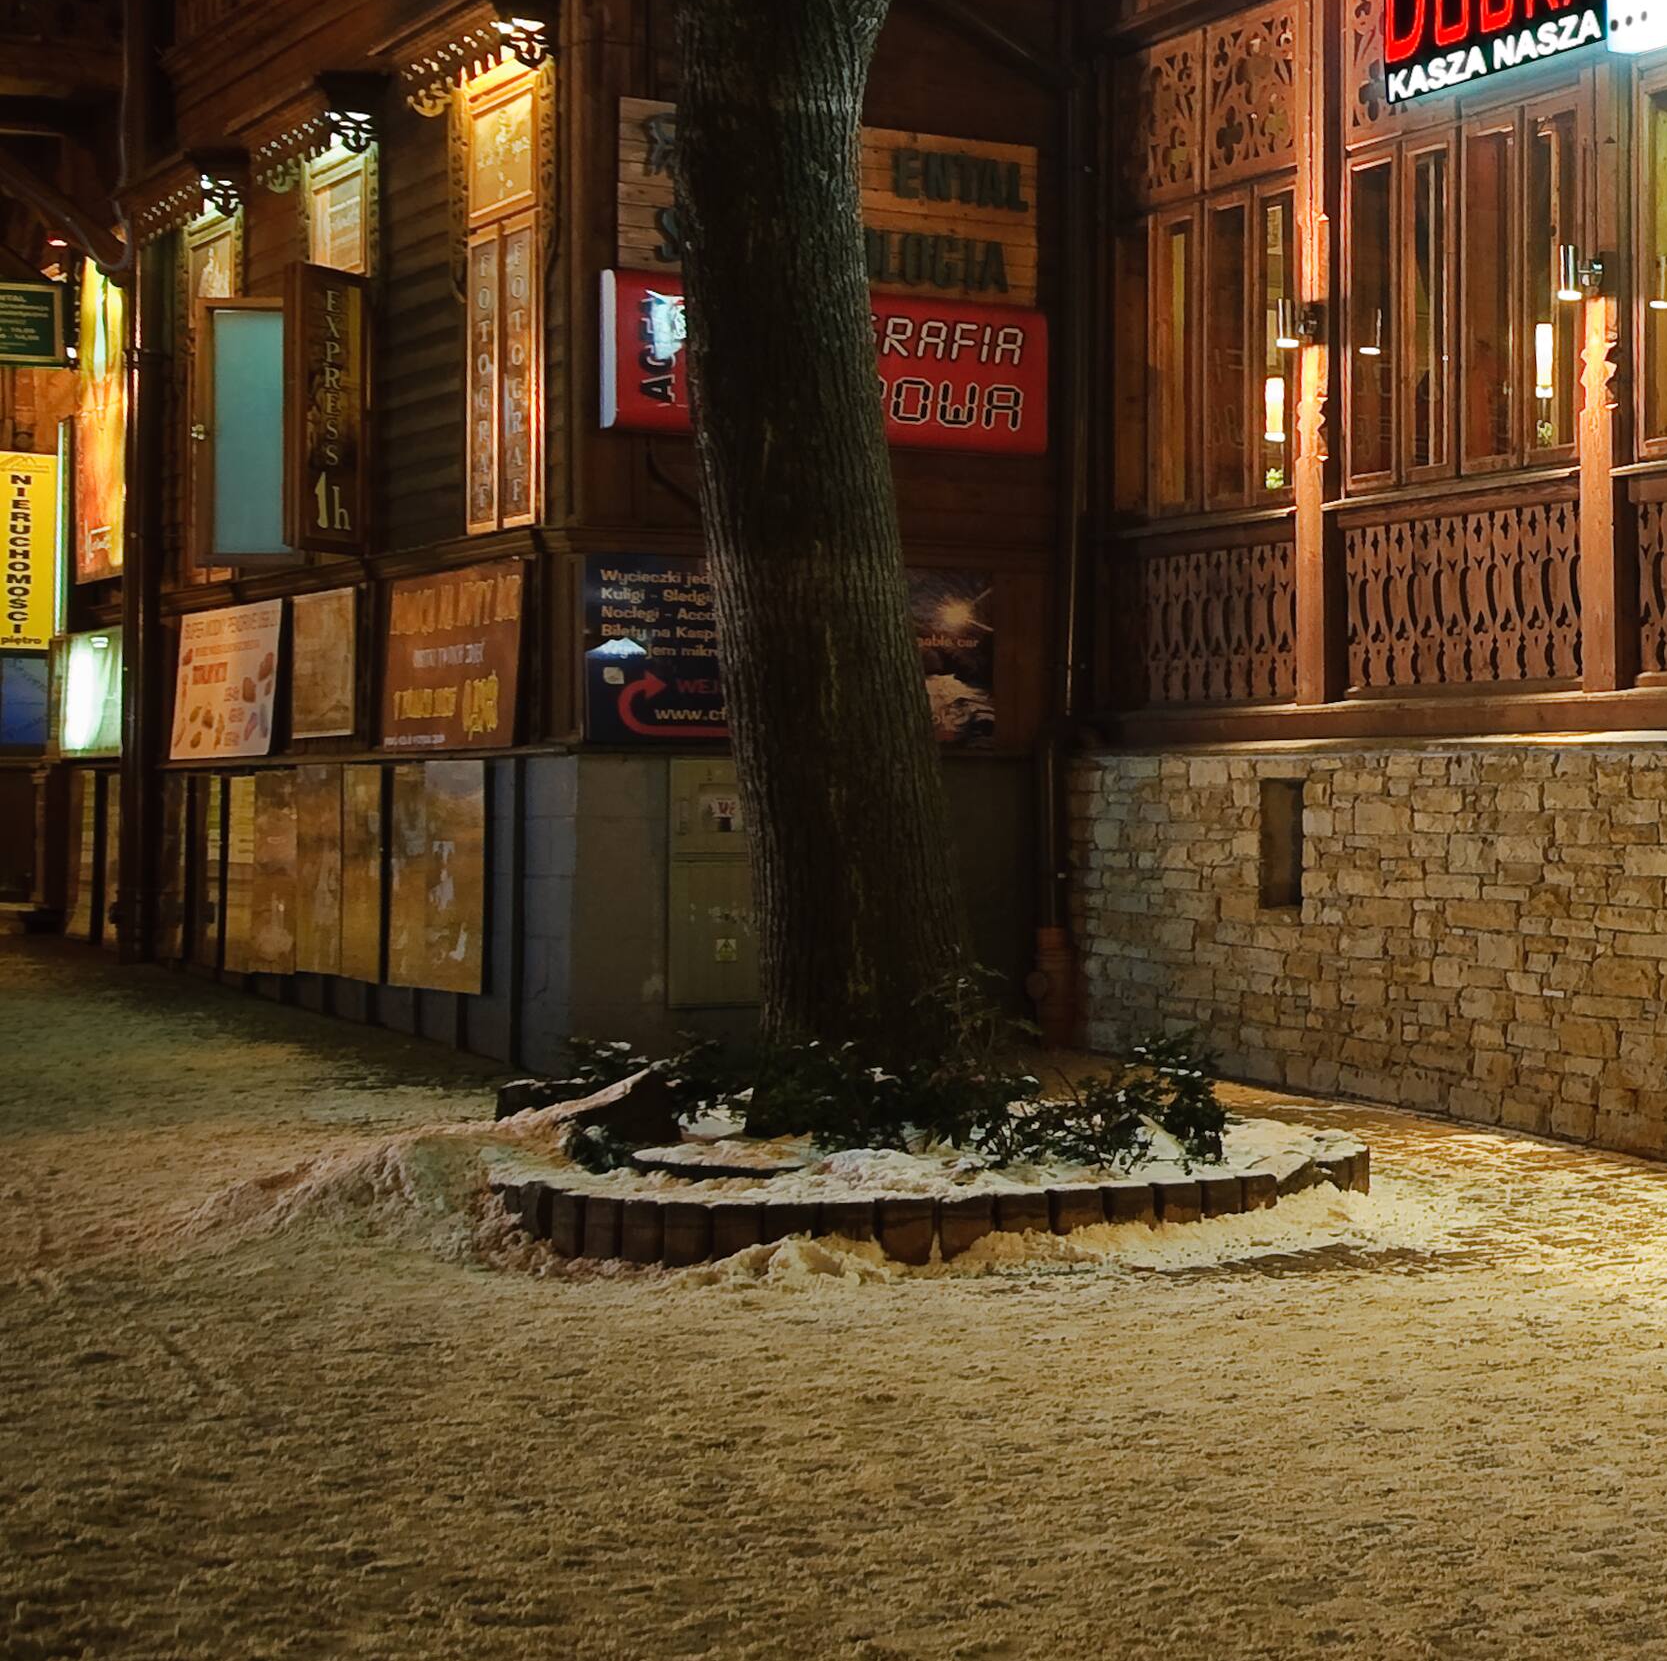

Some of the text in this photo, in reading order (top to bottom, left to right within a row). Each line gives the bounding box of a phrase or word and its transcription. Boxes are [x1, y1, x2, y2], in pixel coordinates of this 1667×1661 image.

[1388, 9, 1602, 102] KASZA NASZA
[324, 290, 341, 466] EXPRESS
[477, 254, 492, 508] FOTOGRAF
[510, 242, 526, 501] FOTOGRAF
[601, 569, 716, 587] Wycieczki jed
[601, 587, 645, 603] Kuligi
[601, 605, 659, 622] Noclegi
[601, 624, 648, 640] Bilety
[652, 629, 671, 638] na
